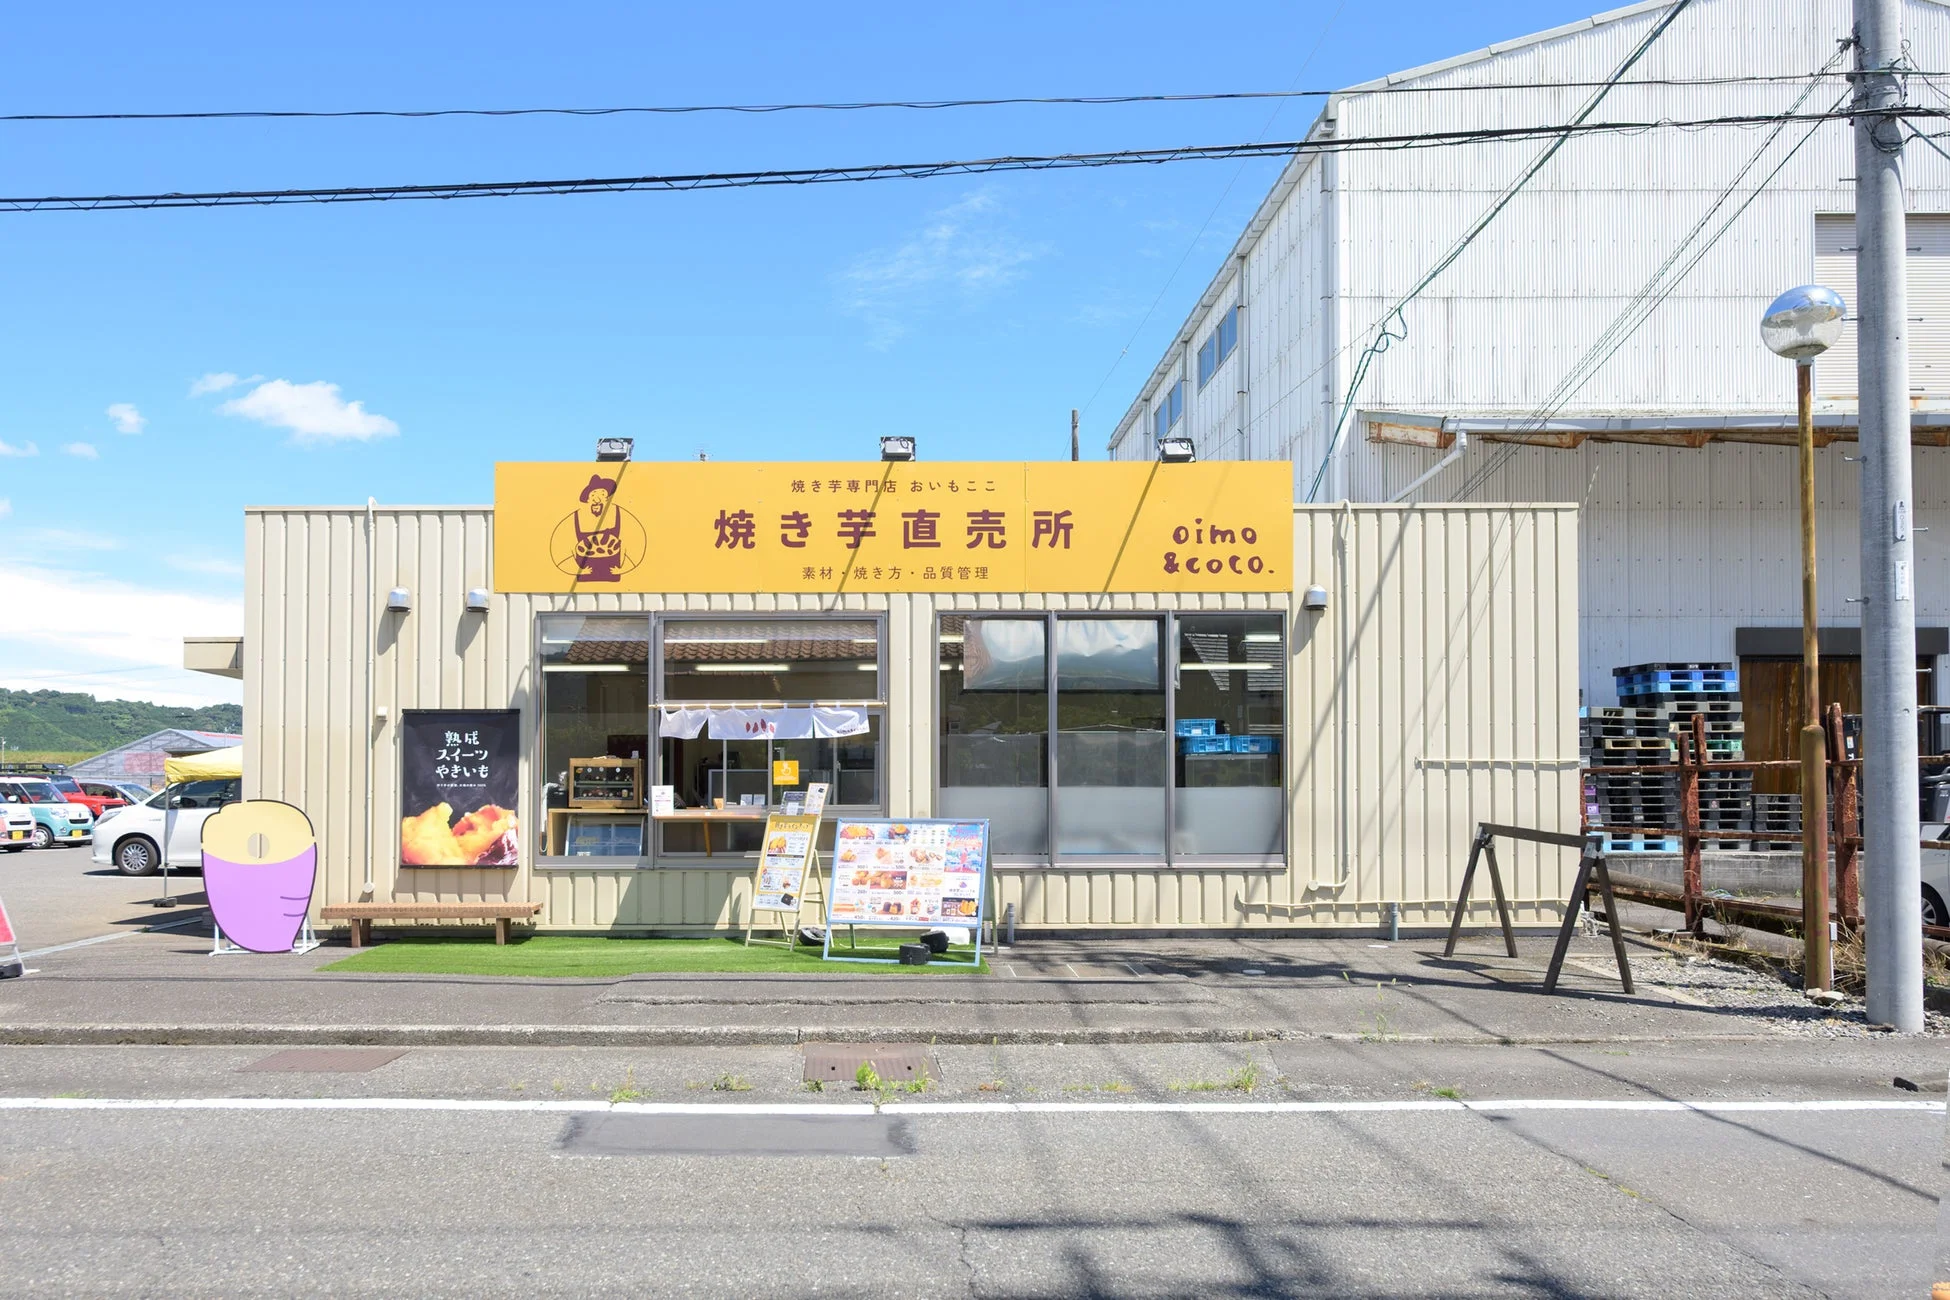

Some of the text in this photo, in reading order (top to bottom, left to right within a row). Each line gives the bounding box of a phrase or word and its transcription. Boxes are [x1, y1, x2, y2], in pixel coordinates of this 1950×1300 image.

[791, 479, 996, 493] 焼き芋専門店 おいもここ
[714, 508, 1073, 549] 焼き芋直売所
[1172, 518, 1257, 545] oimo
[444, 730, 480, 747] 熟成
[435, 748, 489, 762] スイーツ
[435, 764, 489, 779] やきいも
